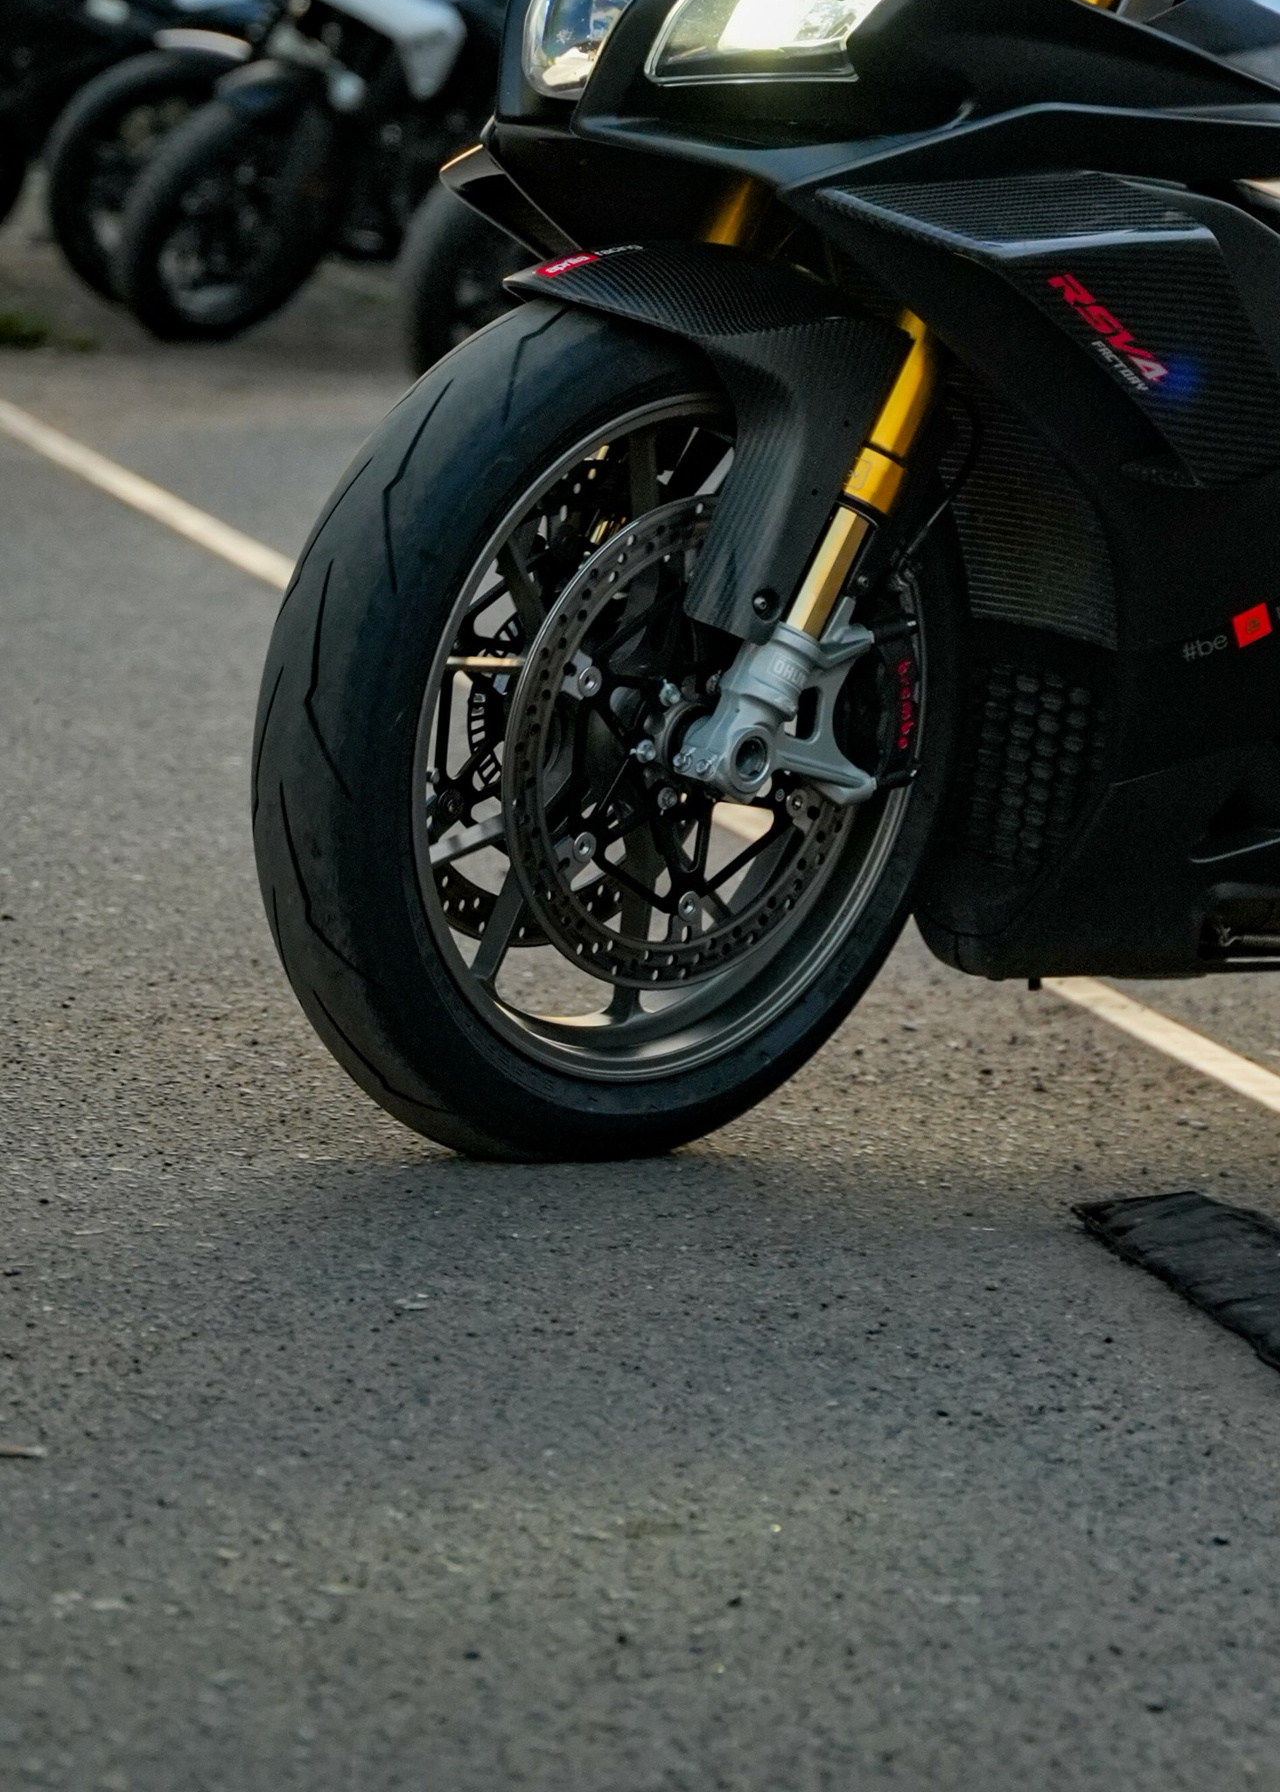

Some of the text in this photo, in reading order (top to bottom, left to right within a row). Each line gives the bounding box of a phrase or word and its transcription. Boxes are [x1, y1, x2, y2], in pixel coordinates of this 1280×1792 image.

[1047, 272, 1170, 383] RSV4
[1091, 339, 1150, 392] FACTORY
[1181, 634, 1229, 663] #be
